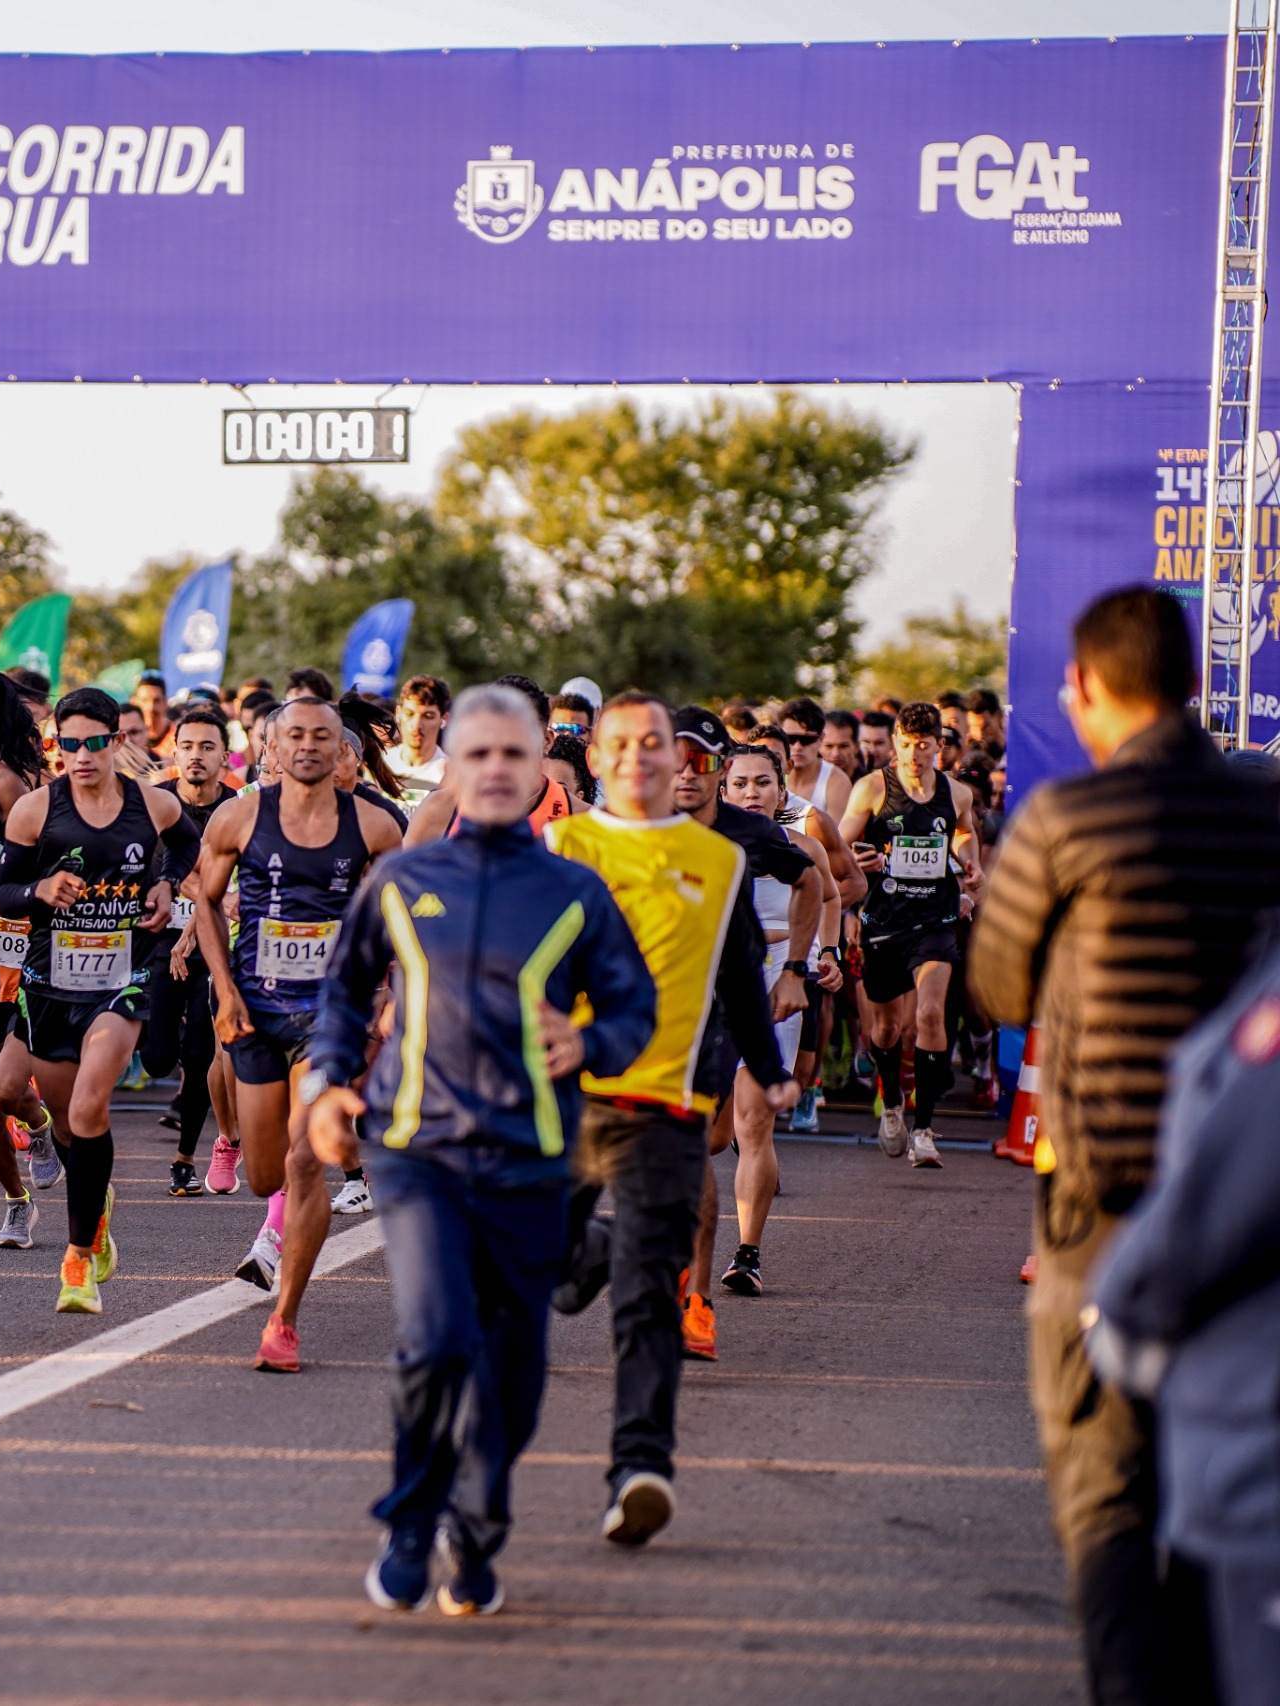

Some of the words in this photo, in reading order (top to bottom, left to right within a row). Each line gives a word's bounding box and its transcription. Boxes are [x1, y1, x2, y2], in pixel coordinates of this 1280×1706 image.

[672, 144, 814, 160] PREFEITURA
[825, 143, 855, 158] DE
[548, 158, 855, 212] ANÁPOLIS
[919, 134, 1090, 220] FGAt
[547, 219, 661, 241] SEMPRE
[666, 218, 708, 240] DO
[713, 217, 770, 241] SEU
[775, 216, 854, 240] LADO
[1014, 210, 1078, 229] FEDERAÇÃO
[1079, 212, 1122, 226] GOIANA
[1014, 229, 1029, 244] DE
[1029, 229, 1089, 244] ATLETISMO
[1176, 449, 1208, 463] ETAP
[1155, 467, 1209, 501] 14
[903, 850, 939, 863] 1043
[98, 898, 141, 916] NÍVEL
[273, 941, 326, 959] 1014
[65, 953, 117, 971] 1777
